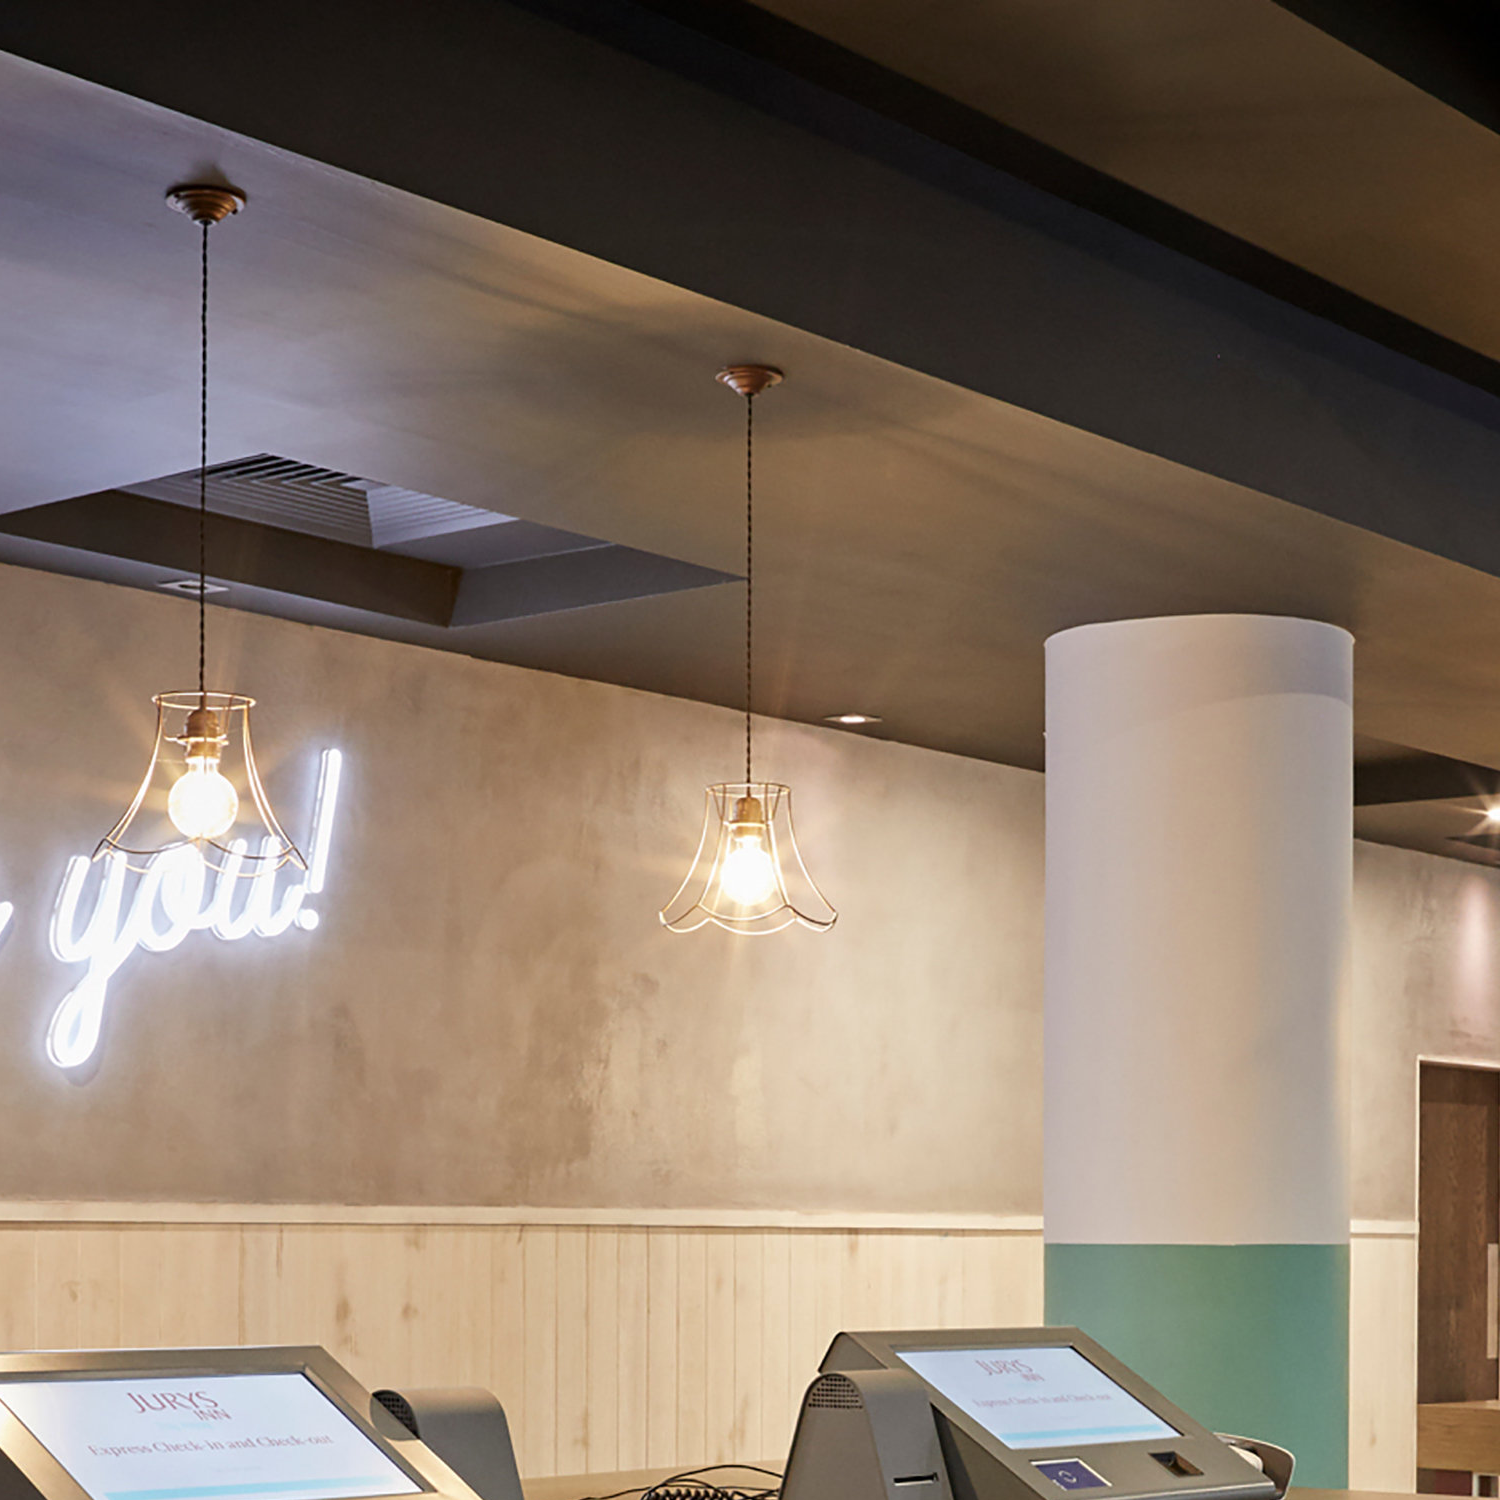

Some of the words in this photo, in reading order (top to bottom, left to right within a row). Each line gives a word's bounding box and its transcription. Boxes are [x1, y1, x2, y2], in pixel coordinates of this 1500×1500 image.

[45, 748, 342, 1068] you!
[127, 1391, 219, 1414] JURYS
[193, 1409, 232, 1421] INN
[87, 1444, 152, 1457] Express
[227, 1436, 256, 1449] and
